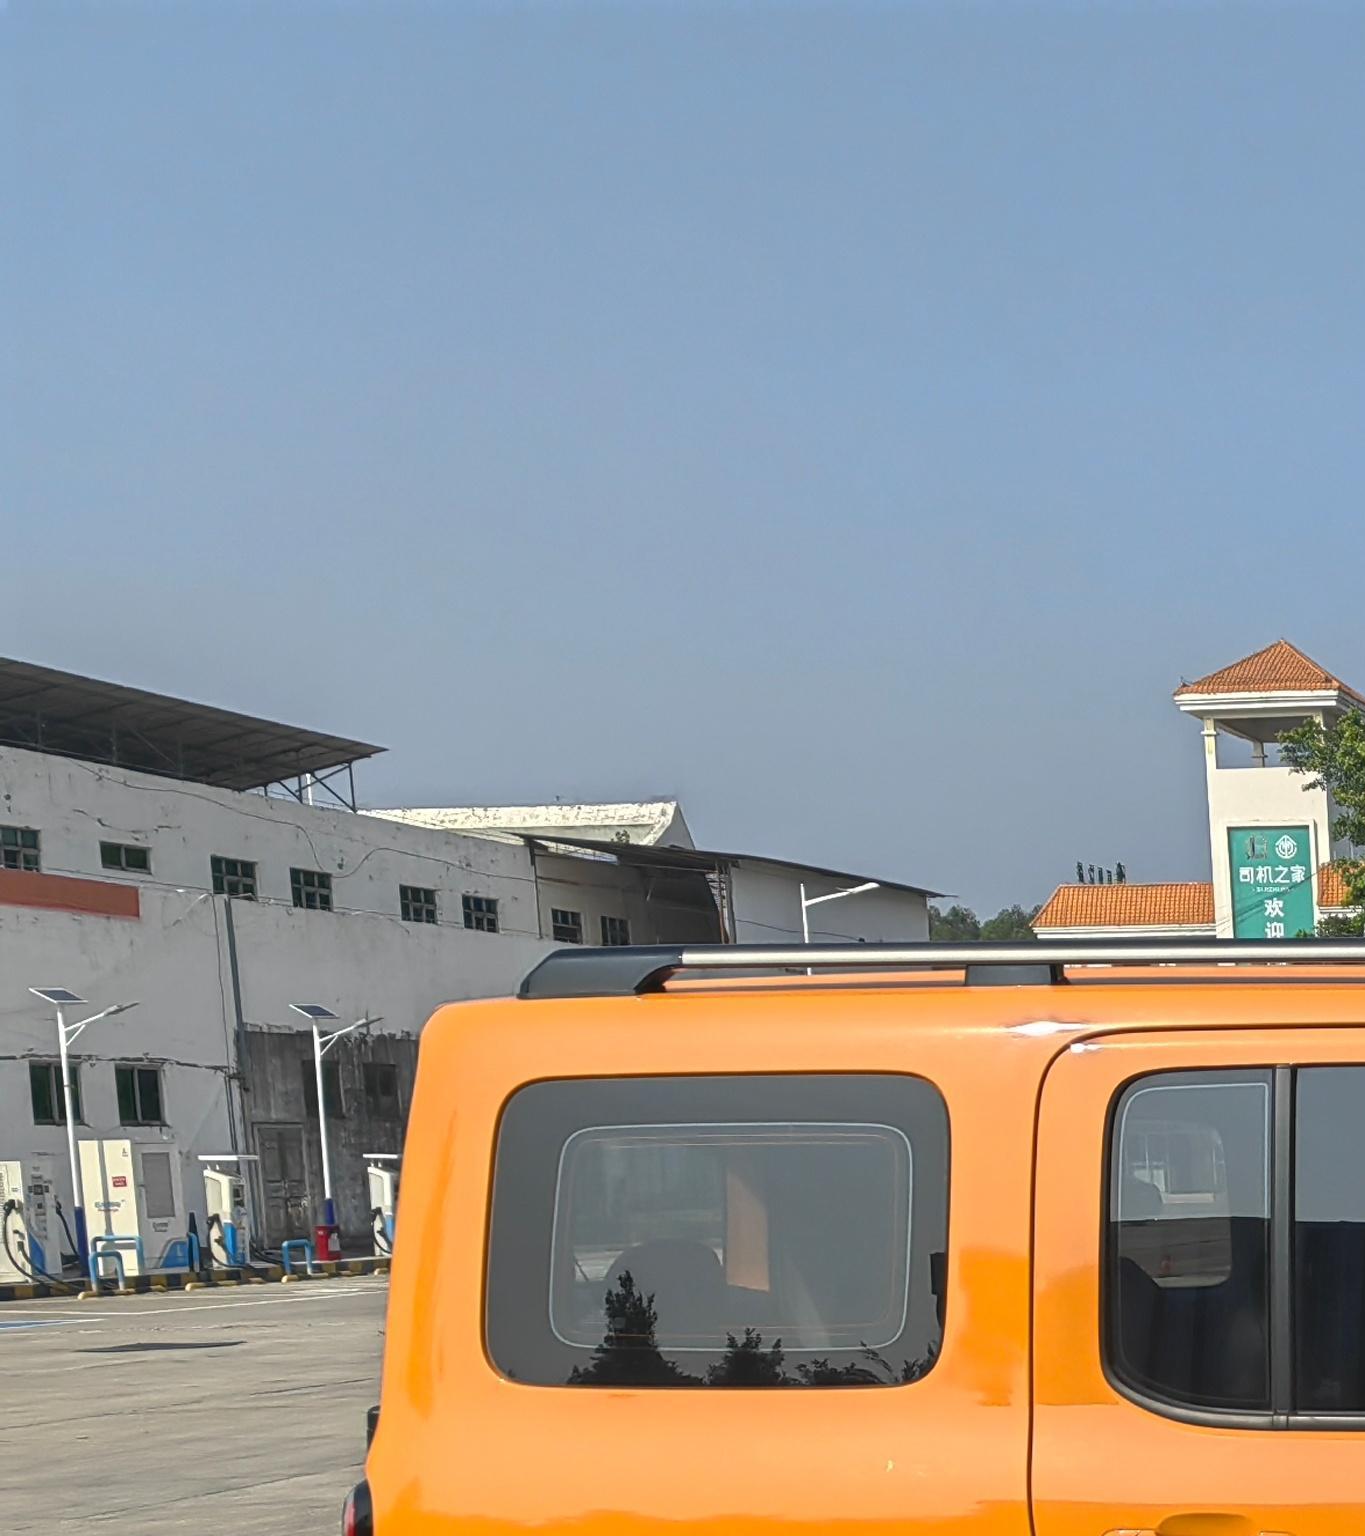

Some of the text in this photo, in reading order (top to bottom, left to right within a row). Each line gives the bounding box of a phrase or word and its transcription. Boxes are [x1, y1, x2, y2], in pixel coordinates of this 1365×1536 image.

[1239, 864, 1306, 884] 司机之家
[1264, 897, 1285, 938] 欢迎
